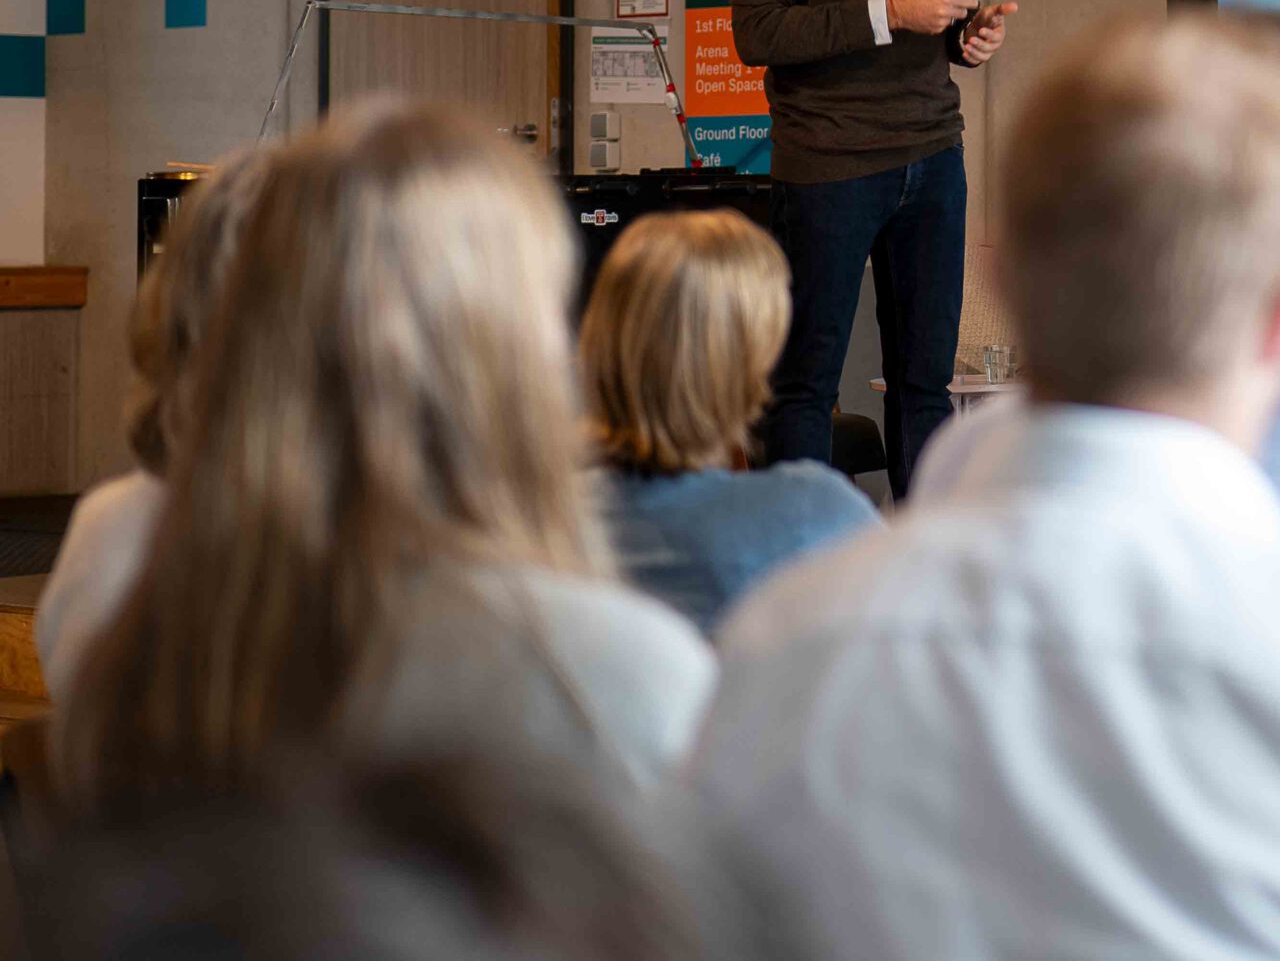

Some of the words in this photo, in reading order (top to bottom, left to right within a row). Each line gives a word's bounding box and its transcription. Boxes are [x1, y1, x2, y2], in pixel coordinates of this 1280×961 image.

[696, 19, 713, 33] 1st
[716, 18, 733, 32] Flo
[696, 46, 729, 59] Arena
[696, 61, 742, 77] Meeting
[696, 79, 726, 95] Open
[728, 78, 764, 94] Space
[694, 126, 736, 141] Ground
[739, 125, 769, 139] Floor
